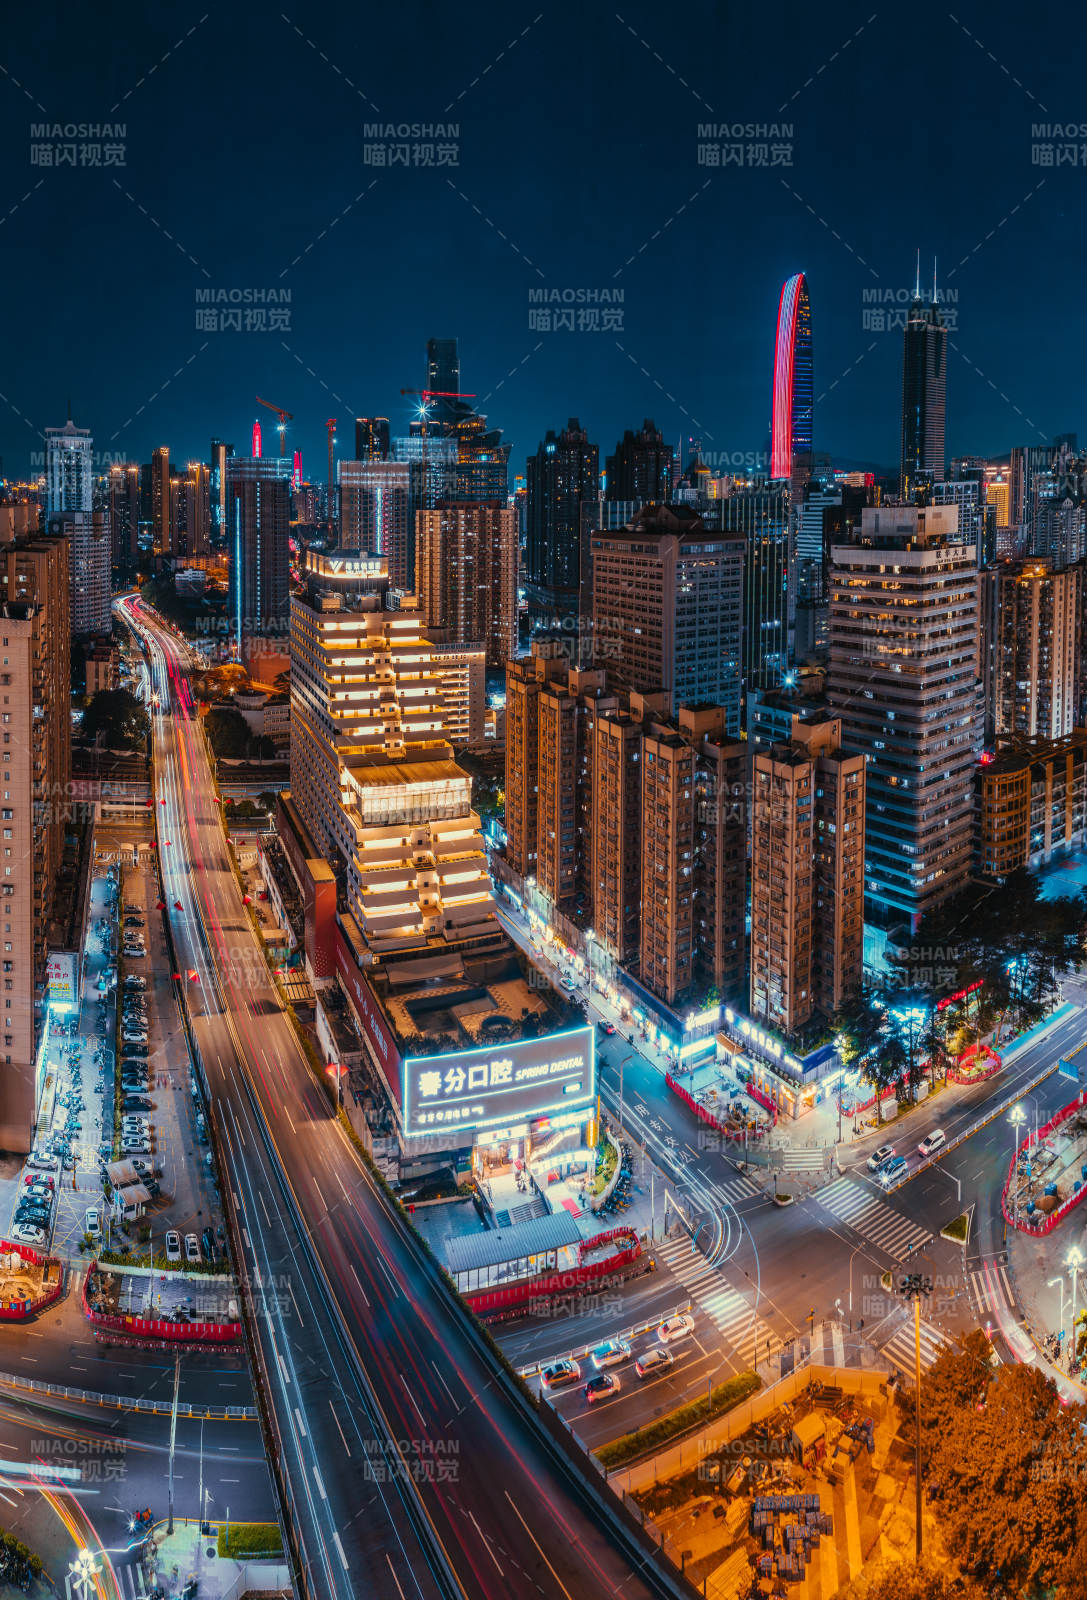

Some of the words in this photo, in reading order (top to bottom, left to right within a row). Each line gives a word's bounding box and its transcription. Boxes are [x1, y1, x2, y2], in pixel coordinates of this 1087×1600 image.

[419, 1059, 513, 1096] 春分口腔
[515, 1064, 549, 1081] SPRING
[550, 1056, 584, 1073] DENTAL
